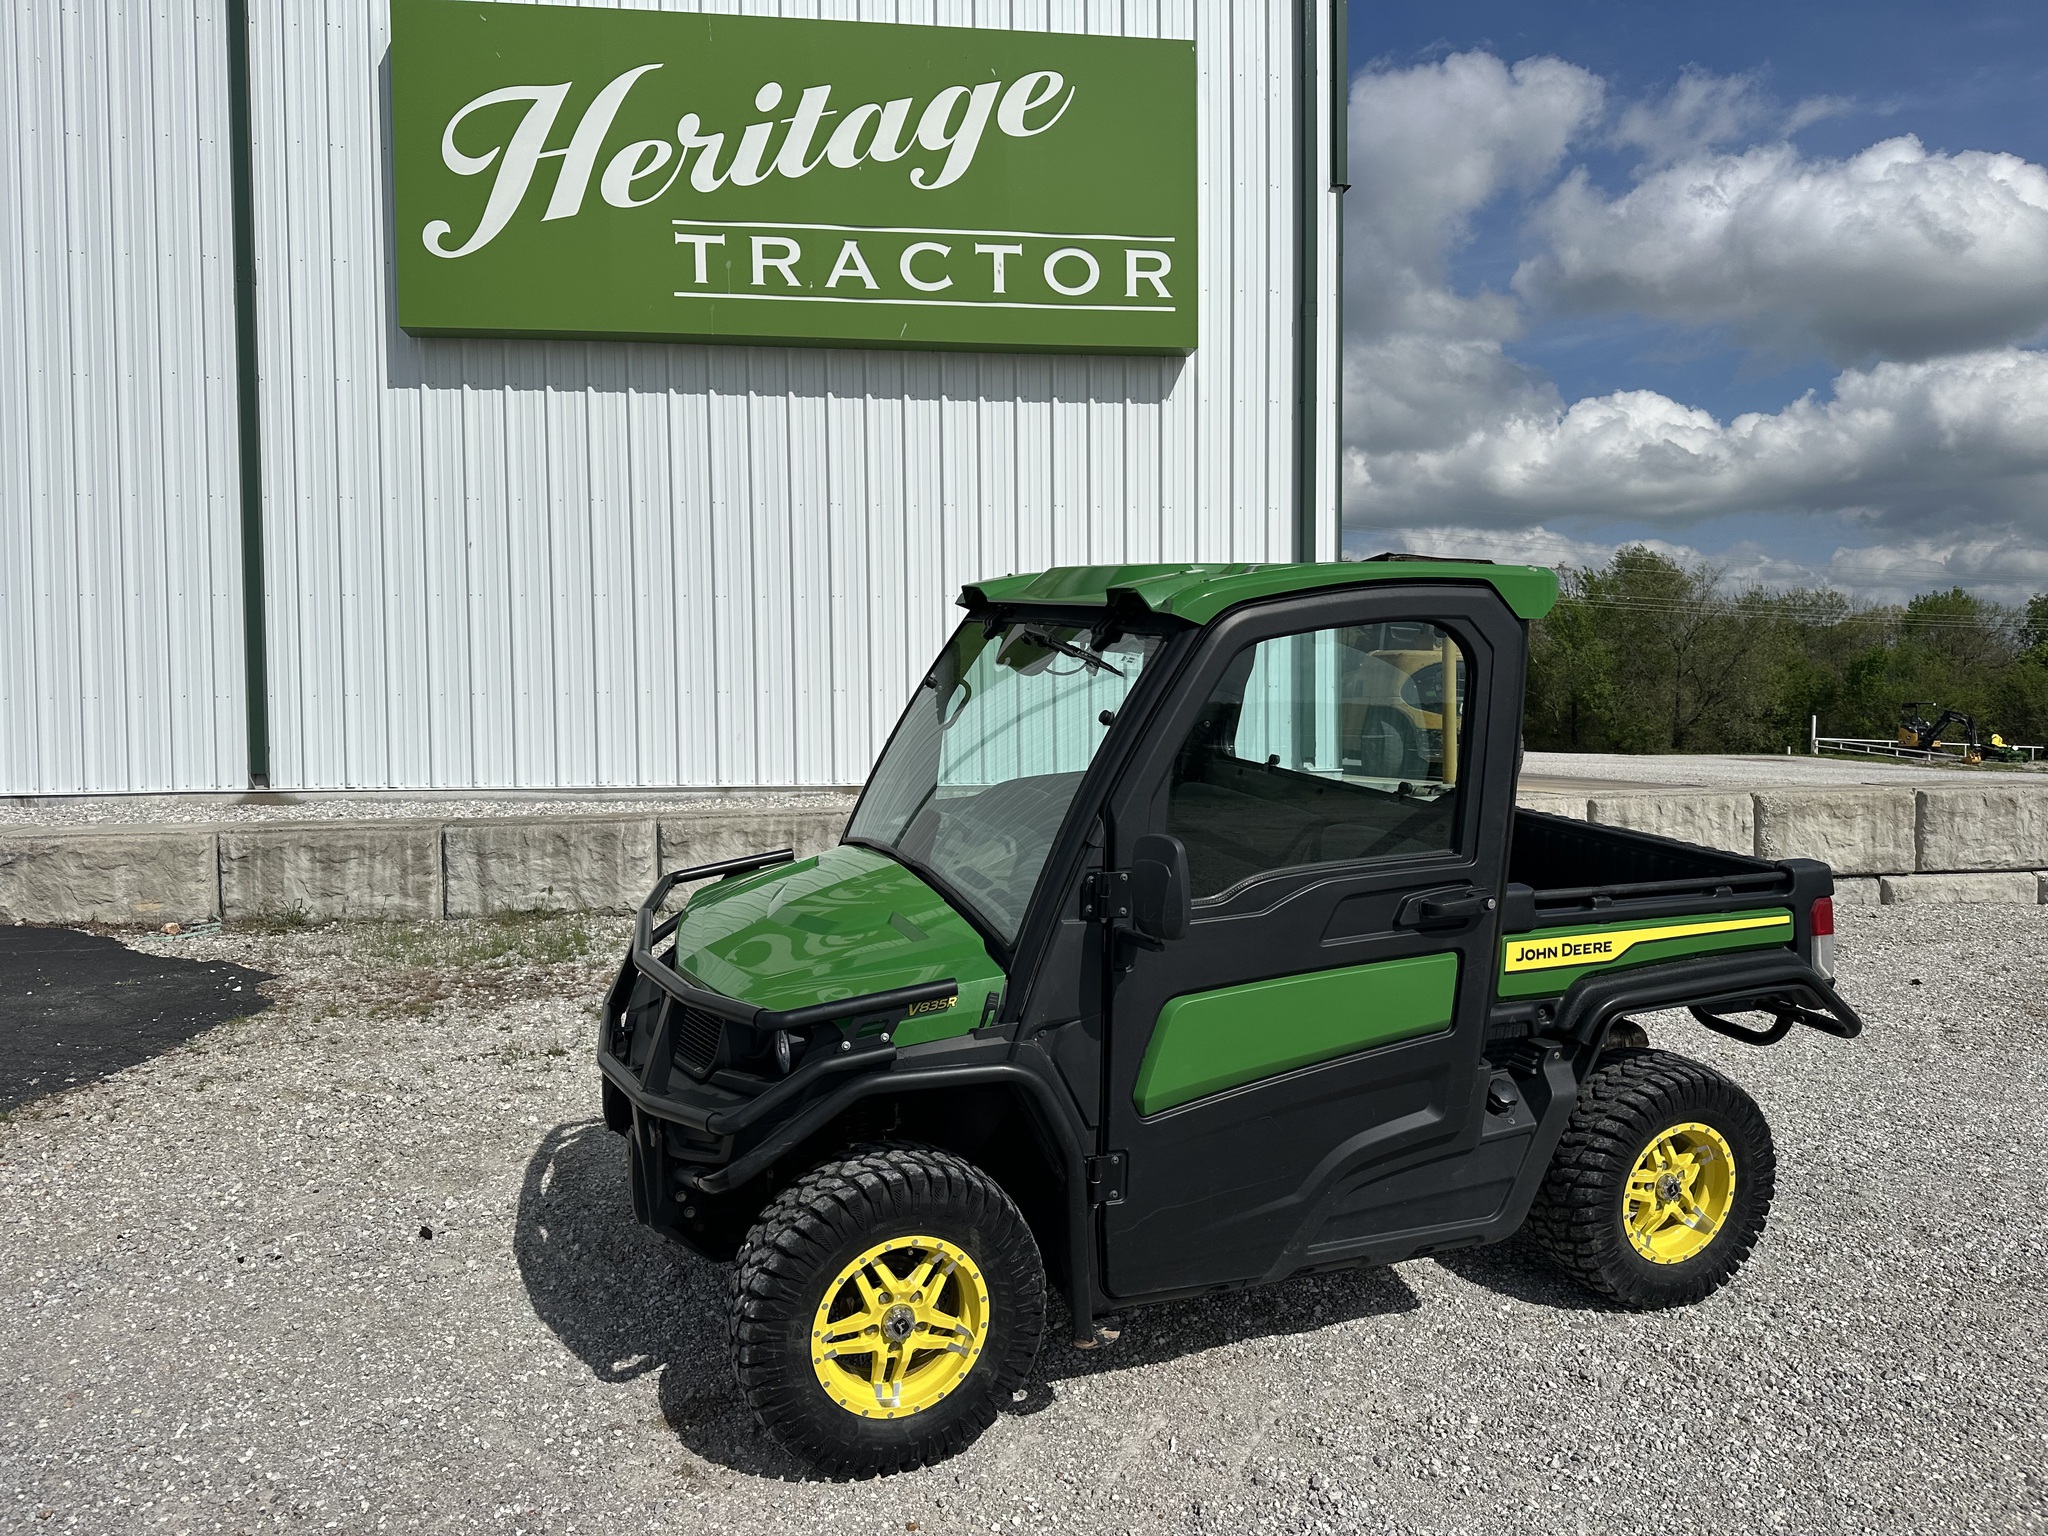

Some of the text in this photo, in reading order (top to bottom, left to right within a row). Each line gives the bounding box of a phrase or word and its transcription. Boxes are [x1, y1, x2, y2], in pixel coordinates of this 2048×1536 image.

[422, 63, 1075, 259] Heritage
[674, 231, 1173, 298] TRACTOR
[1515, 941, 1613, 962] JOHN DEERE
[908, 995, 958, 1016] V835R
